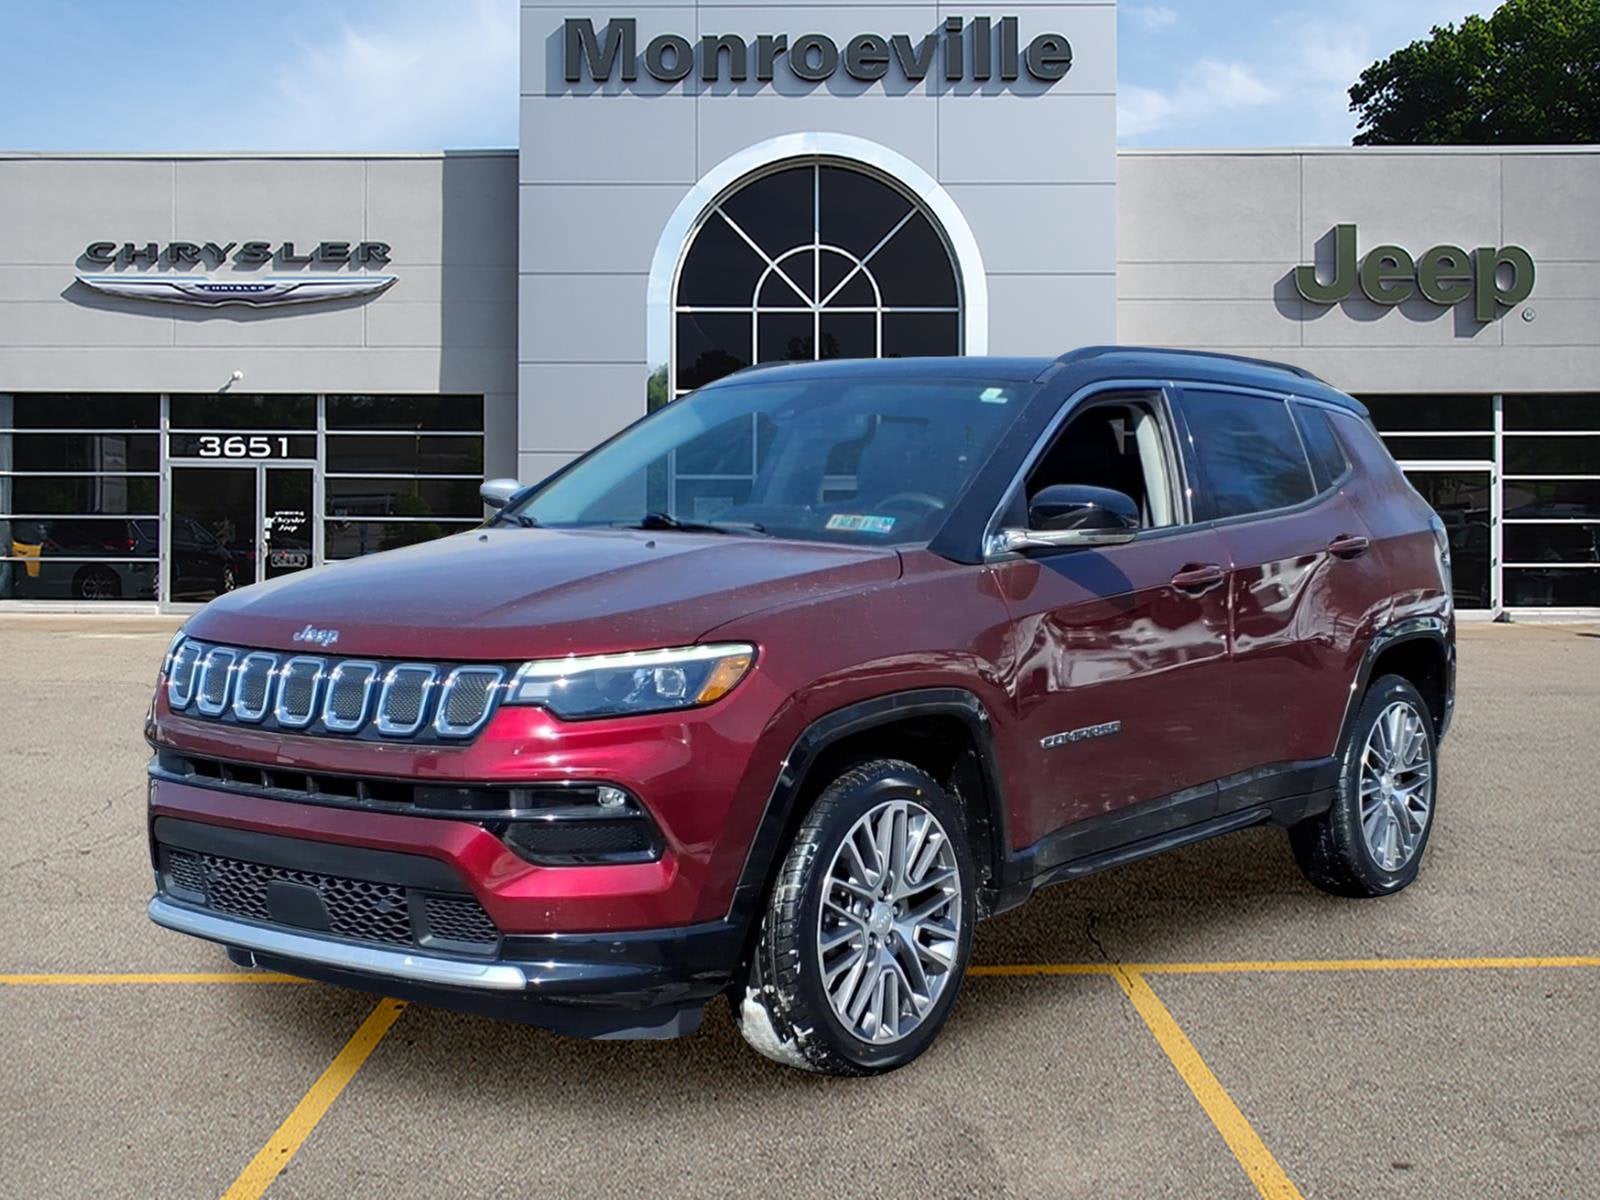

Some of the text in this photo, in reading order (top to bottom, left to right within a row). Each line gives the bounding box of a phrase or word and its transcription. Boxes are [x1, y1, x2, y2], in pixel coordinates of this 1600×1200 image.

[564, 16, 1073, 82] Monroeville
[86, 241, 392, 263] CHRYSLER
[1295, 224, 1536, 322] Jeep
[199, 436, 288, 457] 3651
[293, 624, 340, 647] Jeep
